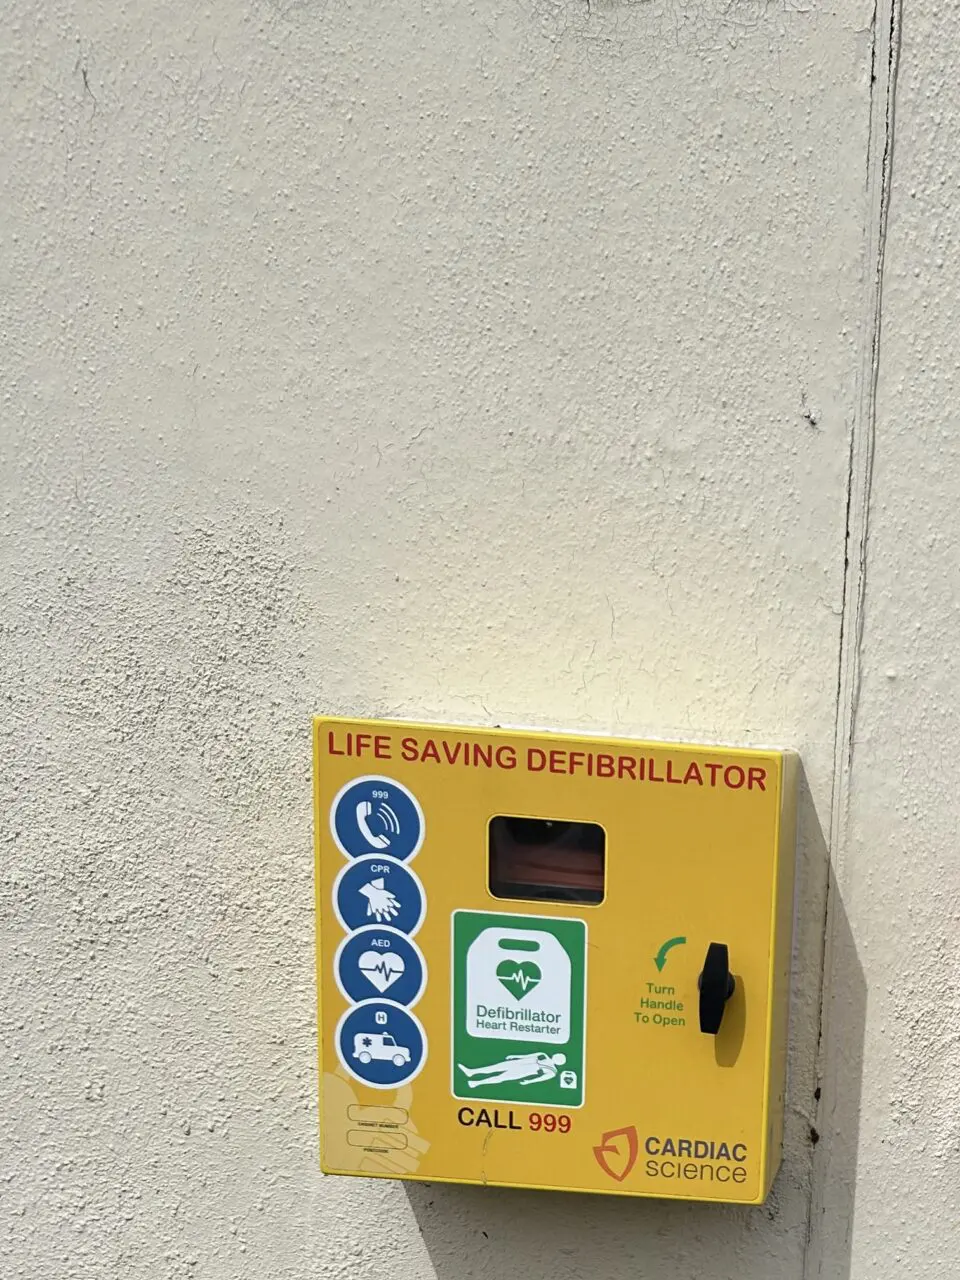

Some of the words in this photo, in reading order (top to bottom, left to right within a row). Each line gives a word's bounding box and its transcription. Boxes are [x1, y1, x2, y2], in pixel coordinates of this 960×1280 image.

[327, 731, 392, 760] LIFE
[400, 737, 517, 770] SAVING
[526, 747, 767, 792] DEFIBRILLATOR
[372, 790, 389, 799] 999
[370, 864, 390, 874] CPR
[371, 938, 391, 948] AED
[646, 983, 675, 996] Turn
[640, 997, 684, 1011] Handle
[476, 1004, 562, 1024] Defibrillator
[633, 1012, 651, 1025] To
[653, 1014, 686, 1027] Open
[476, 1019, 507, 1031] Heart
[510, 1021, 561, 1035] Restarter
[457, 1107, 523, 1130] CALL
[528, 1113, 572, 1134] 999
[645, 1136, 748, 1162] CARDIAC
